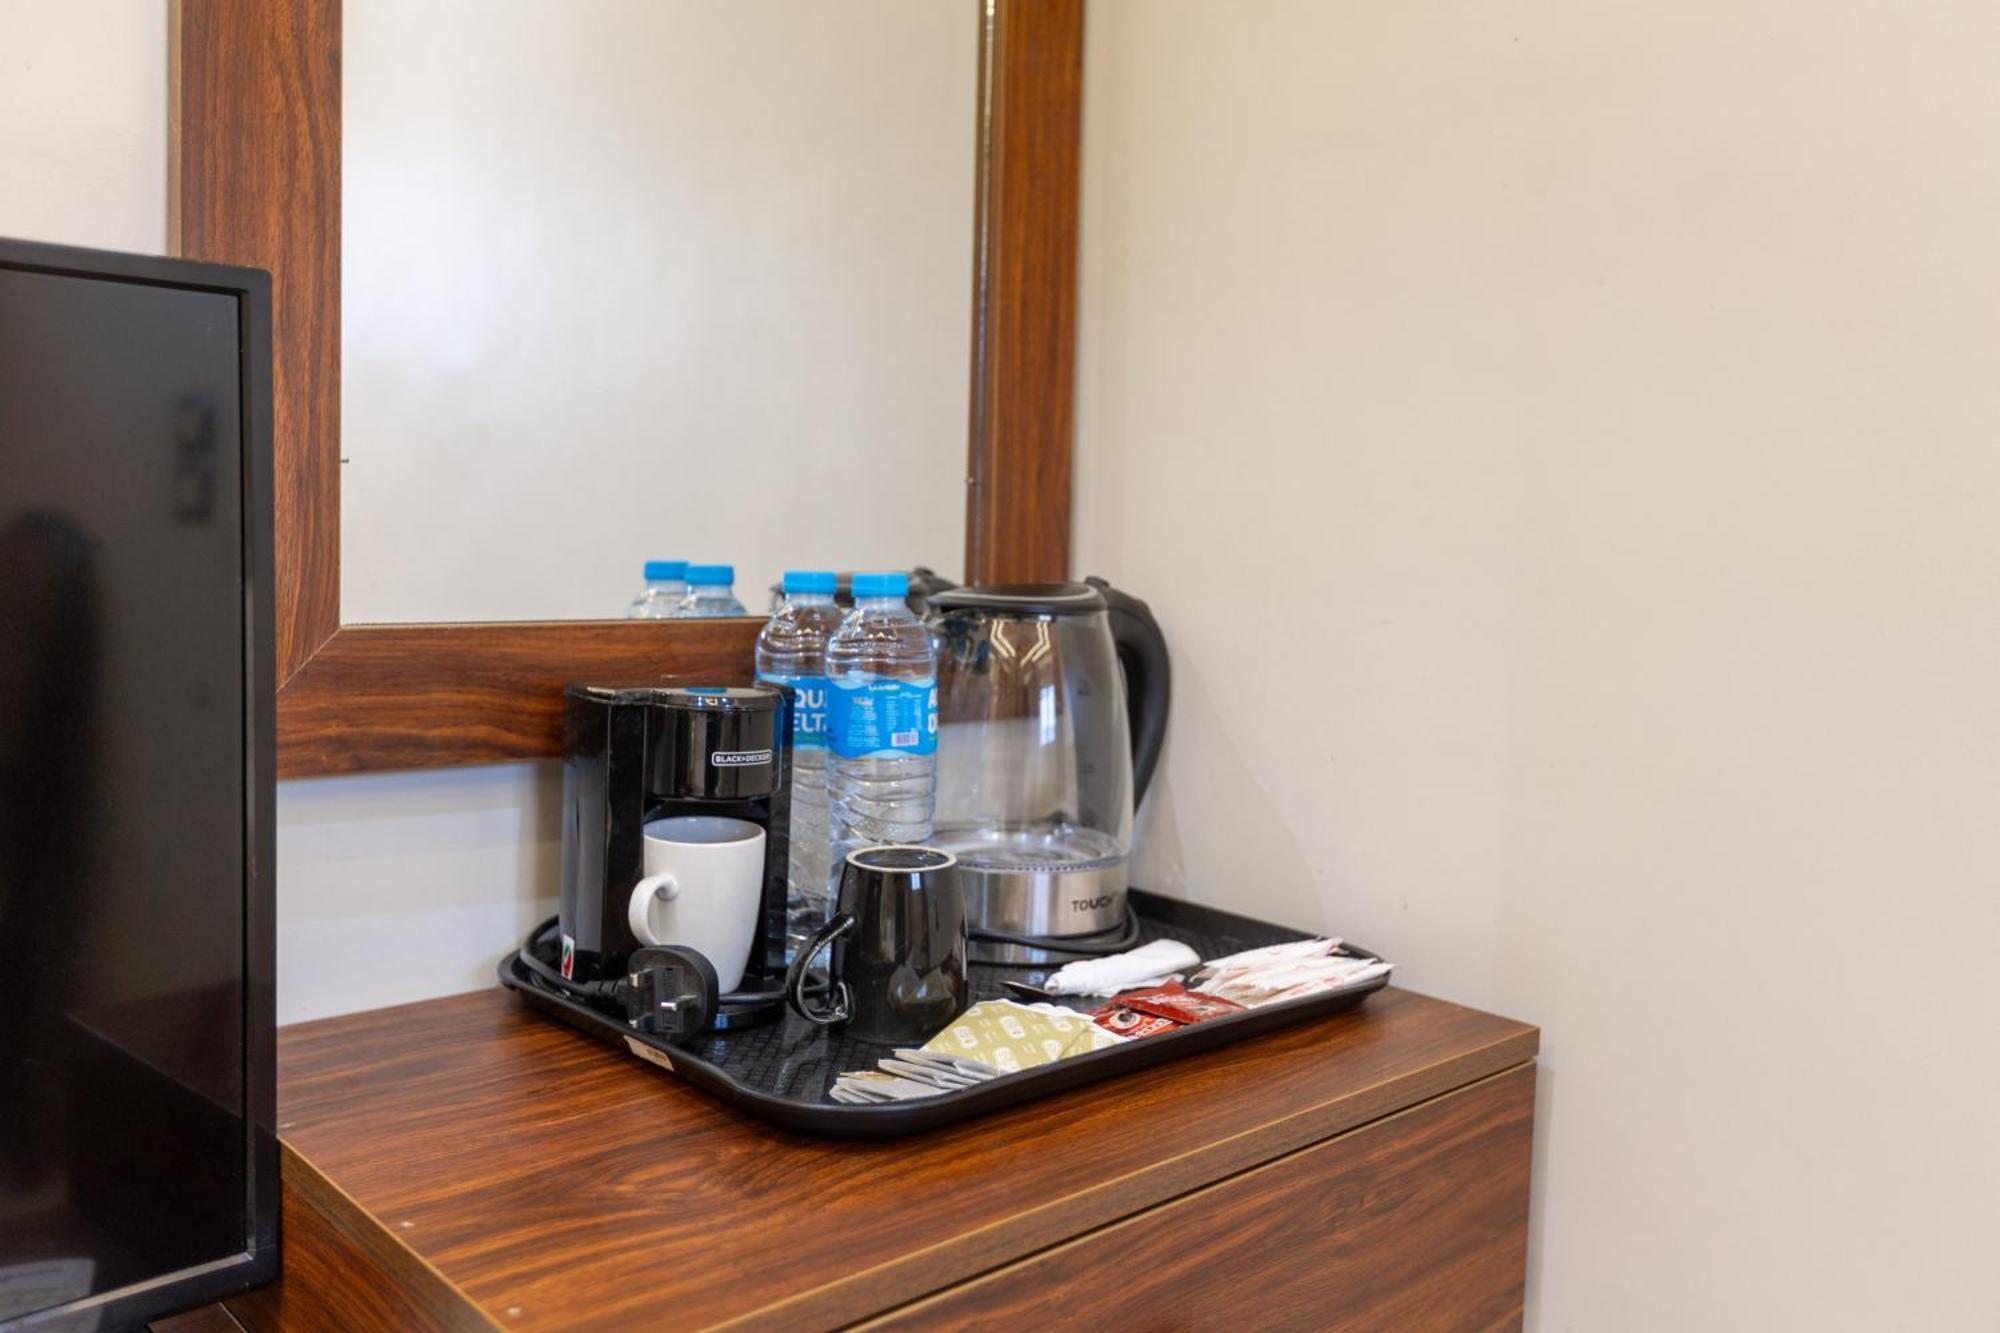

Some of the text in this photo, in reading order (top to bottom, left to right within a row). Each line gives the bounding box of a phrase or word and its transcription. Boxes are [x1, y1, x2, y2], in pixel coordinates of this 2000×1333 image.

[794, 689, 827, 708] QU
[794, 713, 827, 733] ELT
[715, 753, 770, 763] BLACK+DECKER
